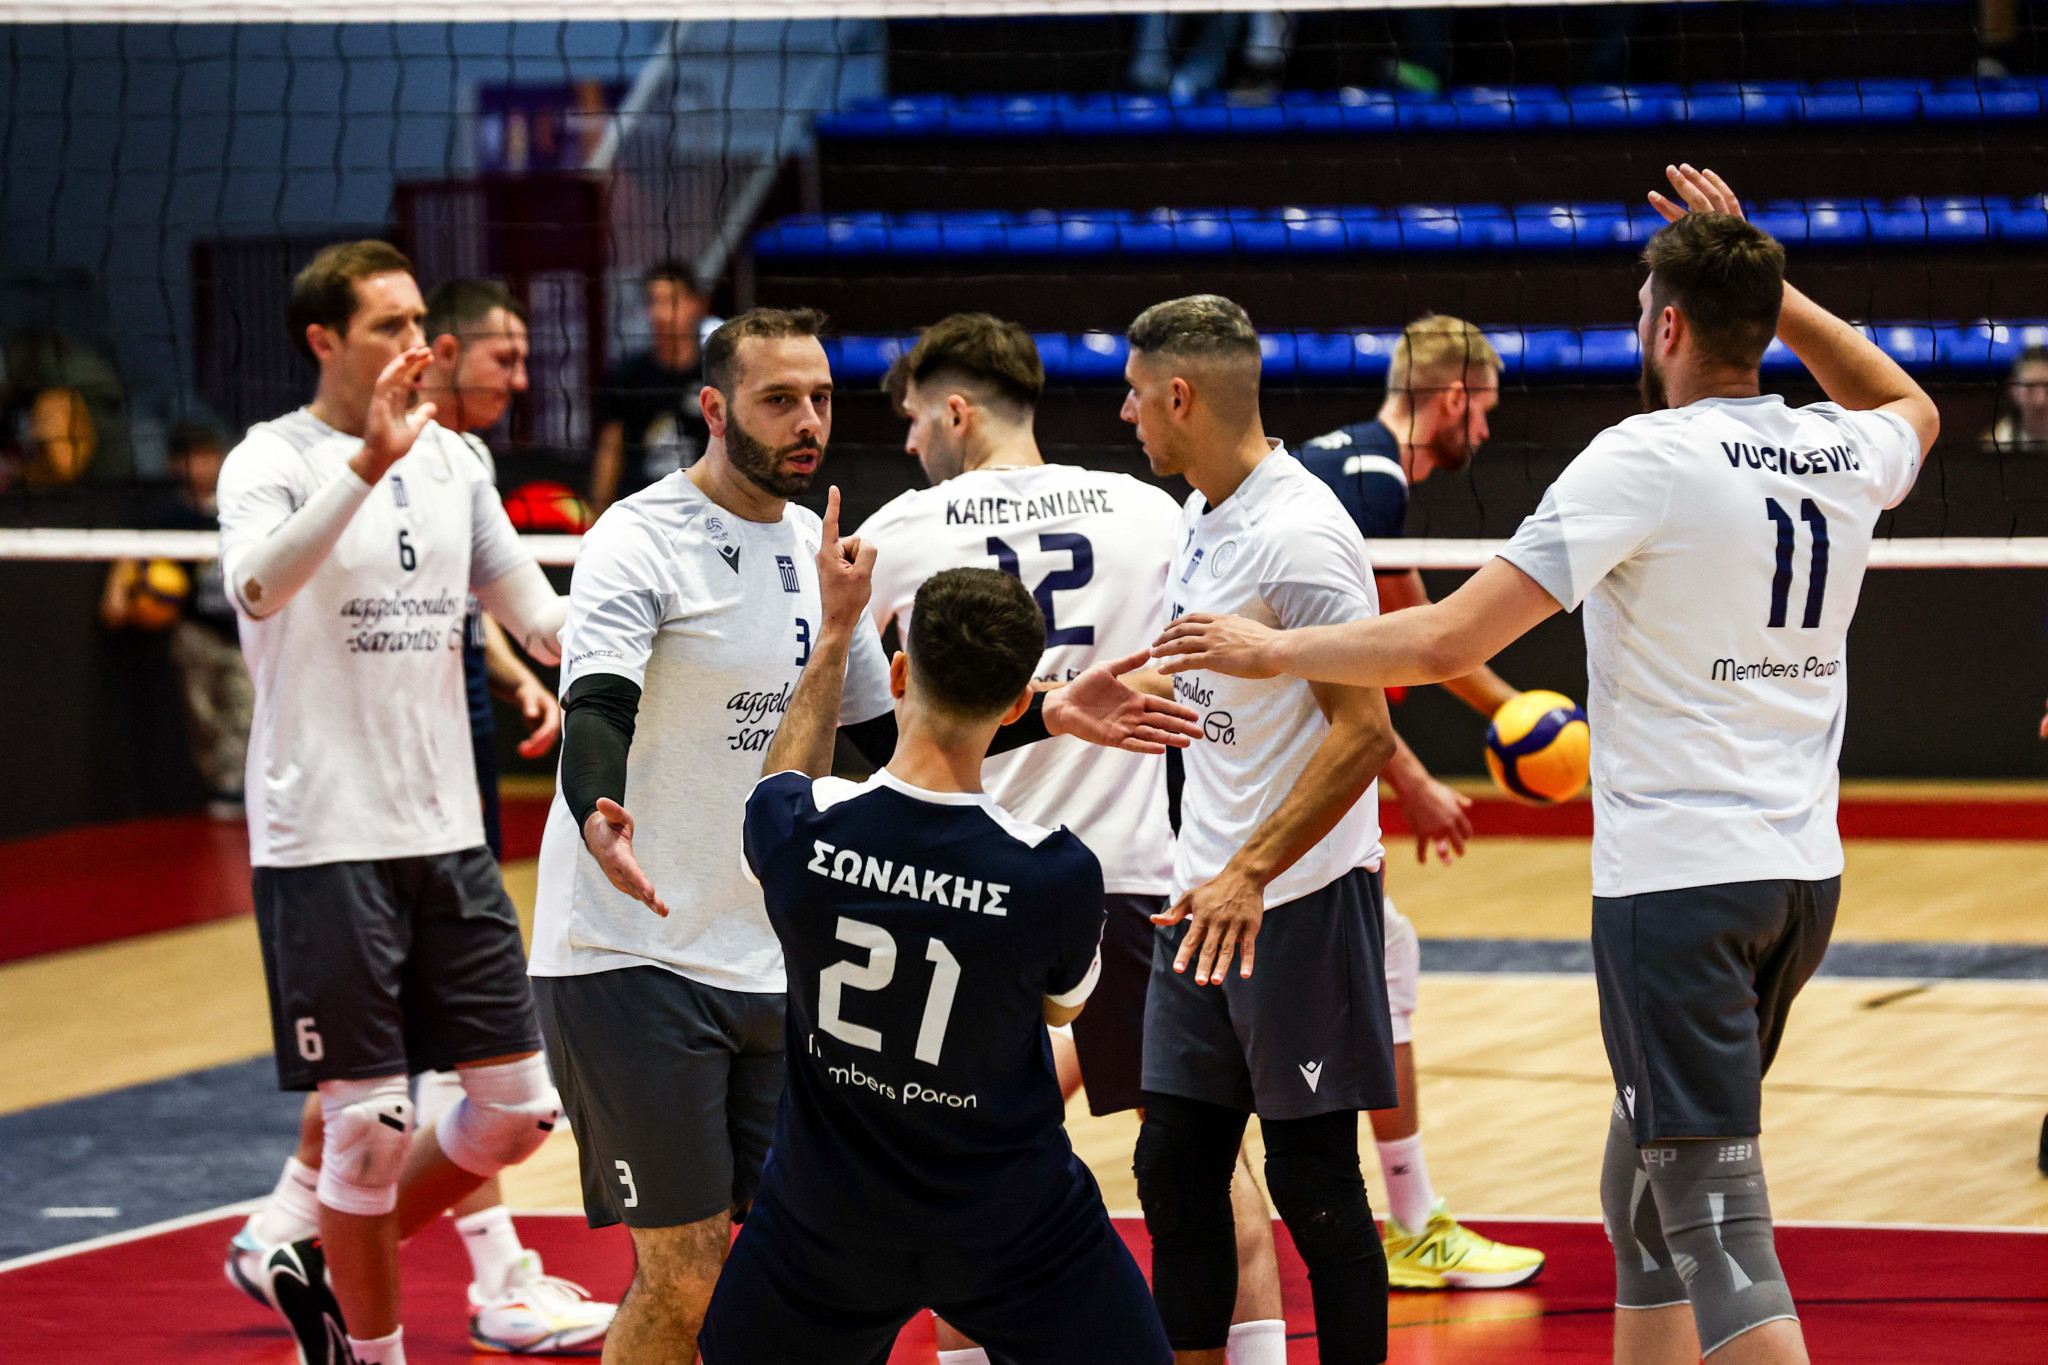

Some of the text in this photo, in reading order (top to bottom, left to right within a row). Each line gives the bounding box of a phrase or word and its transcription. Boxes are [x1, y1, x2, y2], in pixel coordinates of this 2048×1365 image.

[946, 489, 1114, 525] ΚΑΠΕΤΑΝΙΔΗΣ
[398, 530, 416, 571] 6
[1765, 497, 1830, 628] 11
[795, 617, 811, 666] 3
[1711, 656, 1799, 682] Members
[807, 839, 1011, 917] ΣΩΝΑΚΗΣ
[818, 915, 962, 1067] 21
[295, 1017, 324, 1061] 6
[808, 1033, 977, 1109] mbers Paron
[615, 1159, 638, 1208] 3
